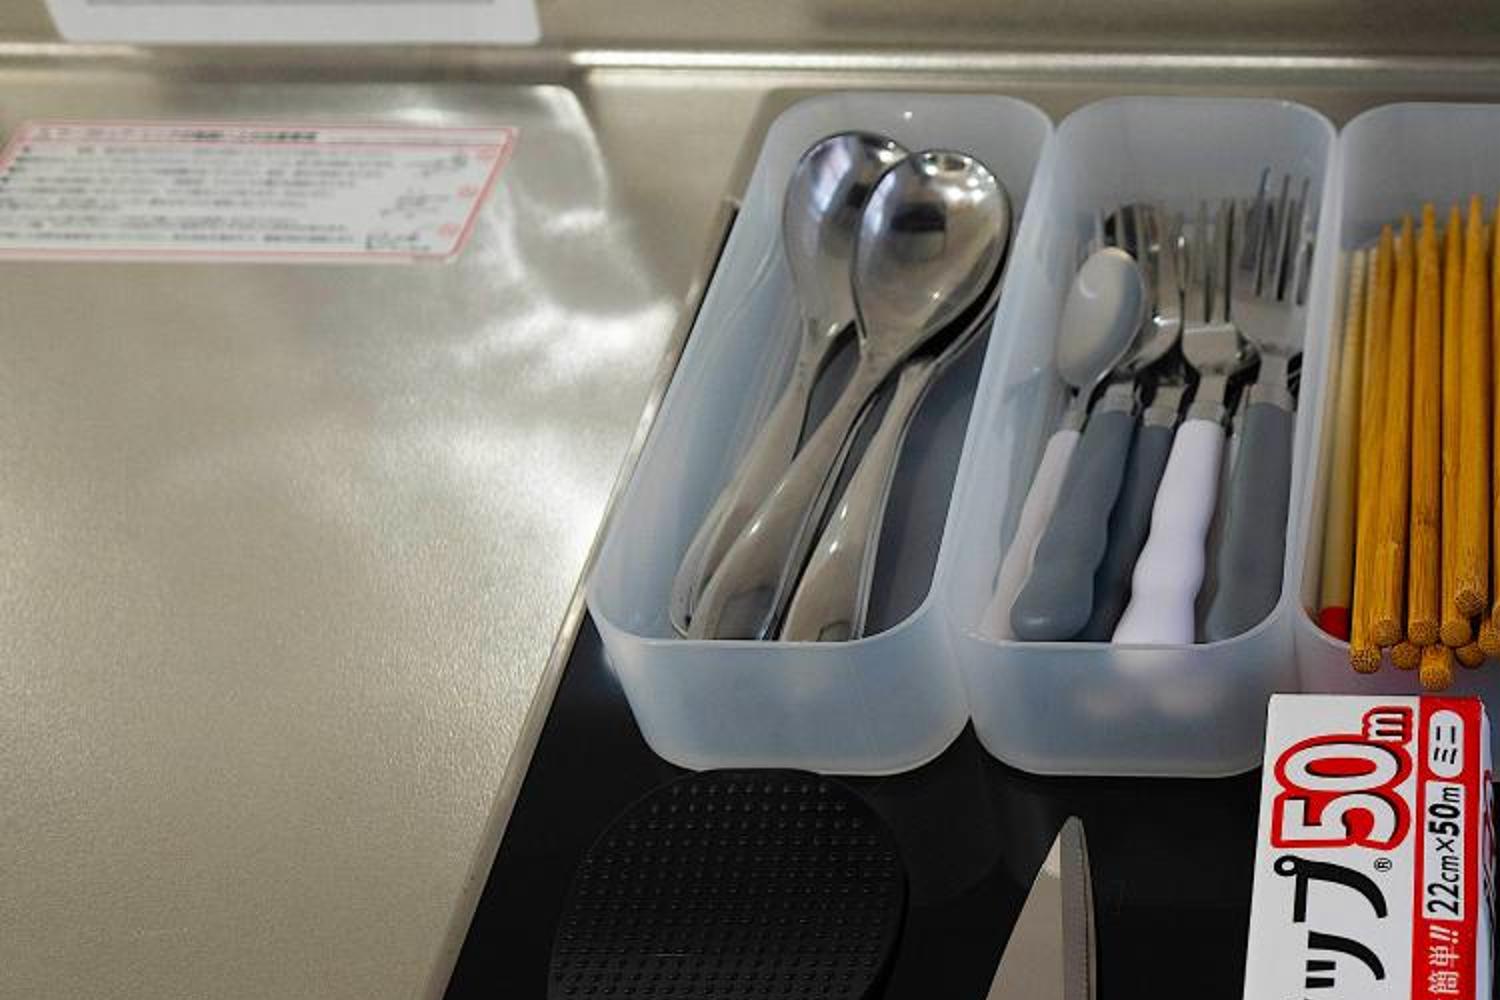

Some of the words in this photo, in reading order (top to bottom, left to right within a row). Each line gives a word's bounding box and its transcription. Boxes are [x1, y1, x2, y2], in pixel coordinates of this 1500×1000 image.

[1271, 706, 1413, 850] 50m
[1434, 726, 1457, 765] ミニ
[1428, 787, 1461, 916] 22cm×50m
